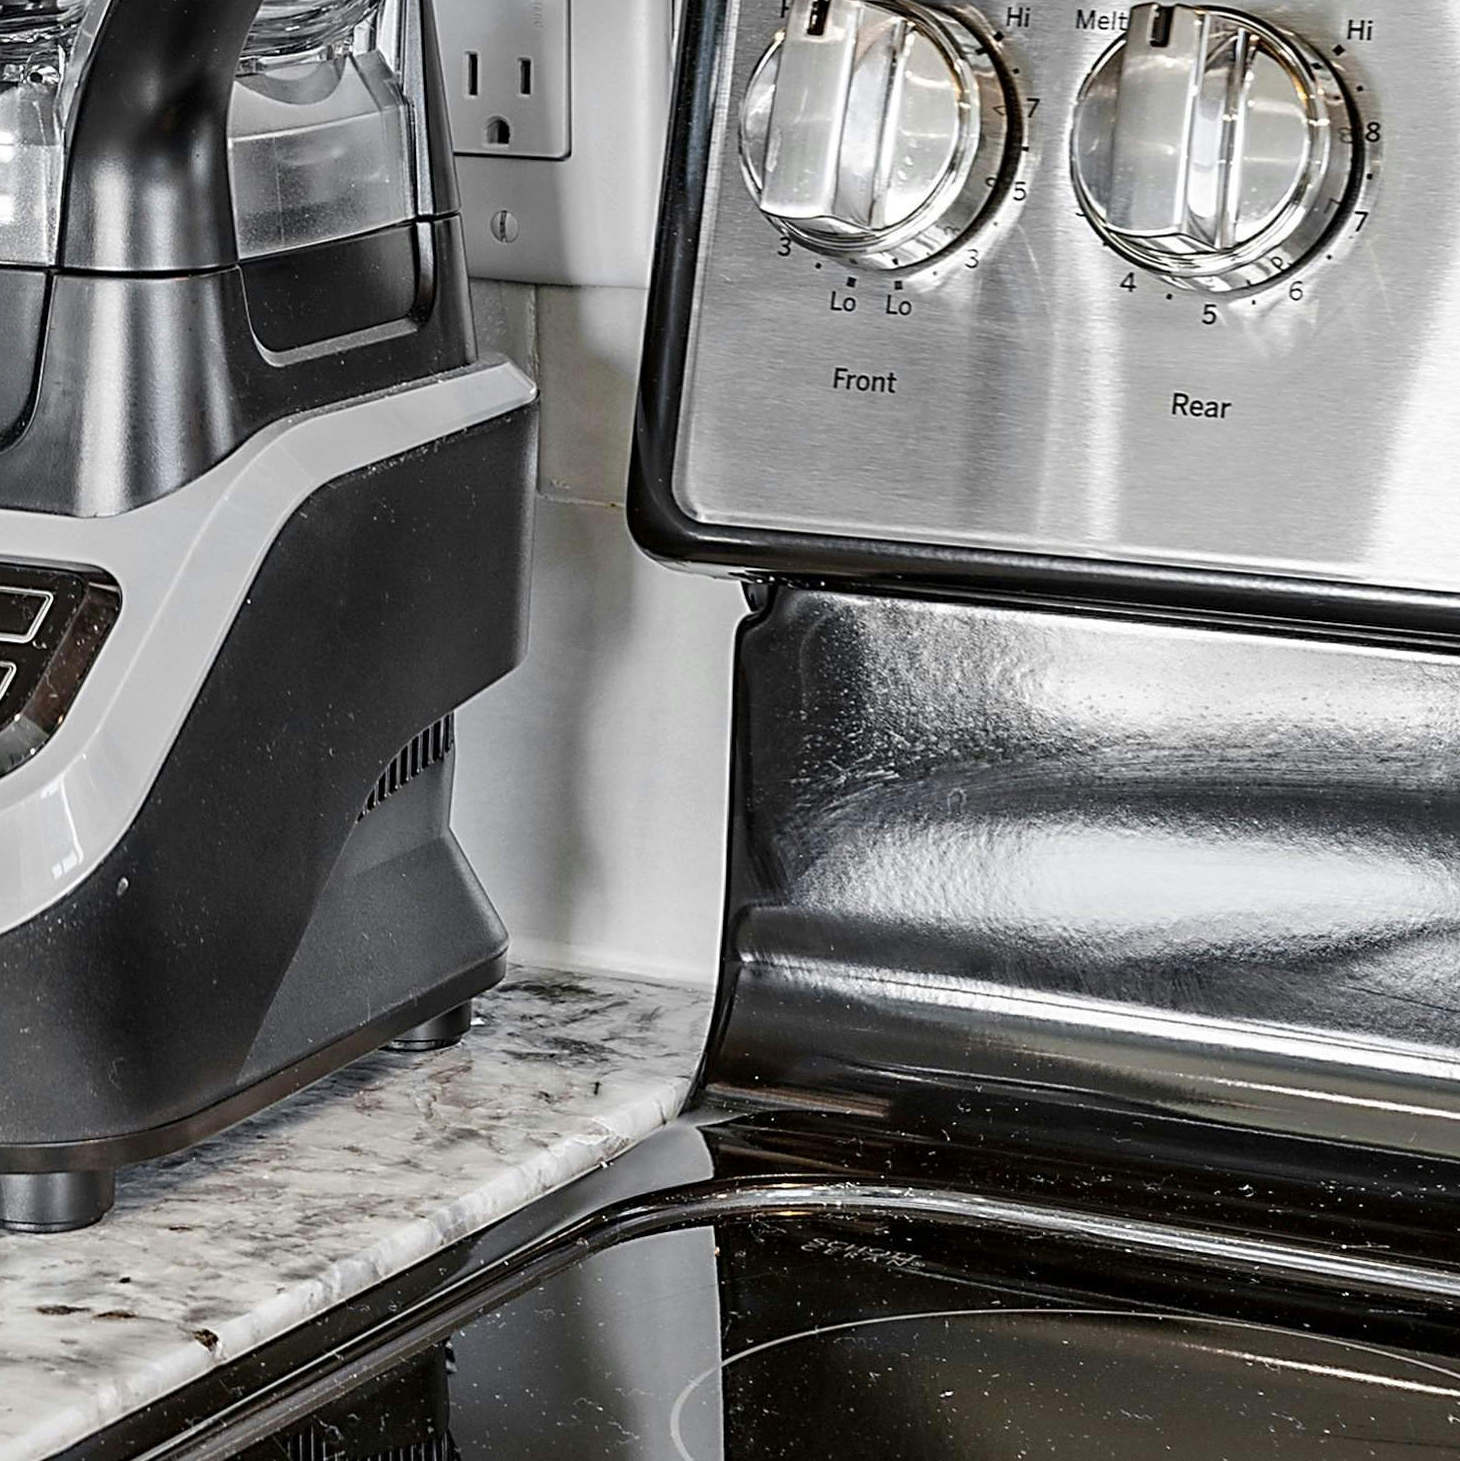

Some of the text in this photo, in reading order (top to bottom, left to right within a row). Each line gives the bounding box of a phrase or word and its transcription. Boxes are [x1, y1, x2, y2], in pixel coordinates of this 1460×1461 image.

[1006, 7, 1031, 29] Hi
[1075, 9, 1129, 32] Melt
[1347, 19, 1374, 42] Hi
[1026, 97, 1041, 119] 7
[1365, 121, 1381, 143] 8
[1013, 181, 1027, 201] 5
[1353, 211, 1369, 233] 7
[777, 236, 792, 257] 3
[965, 248, 980, 269] 3
[1120, 271, 1137, 293] 4
[1288, 280, 1304, 301] 6
[830, 291, 857, 312] Lo
[885, 294, 912, 316] Lo
[1201, 303, 1217, 325] 5
[832, 367, 897, 394] Front
[1171, 392, 1232, 419] Rear
